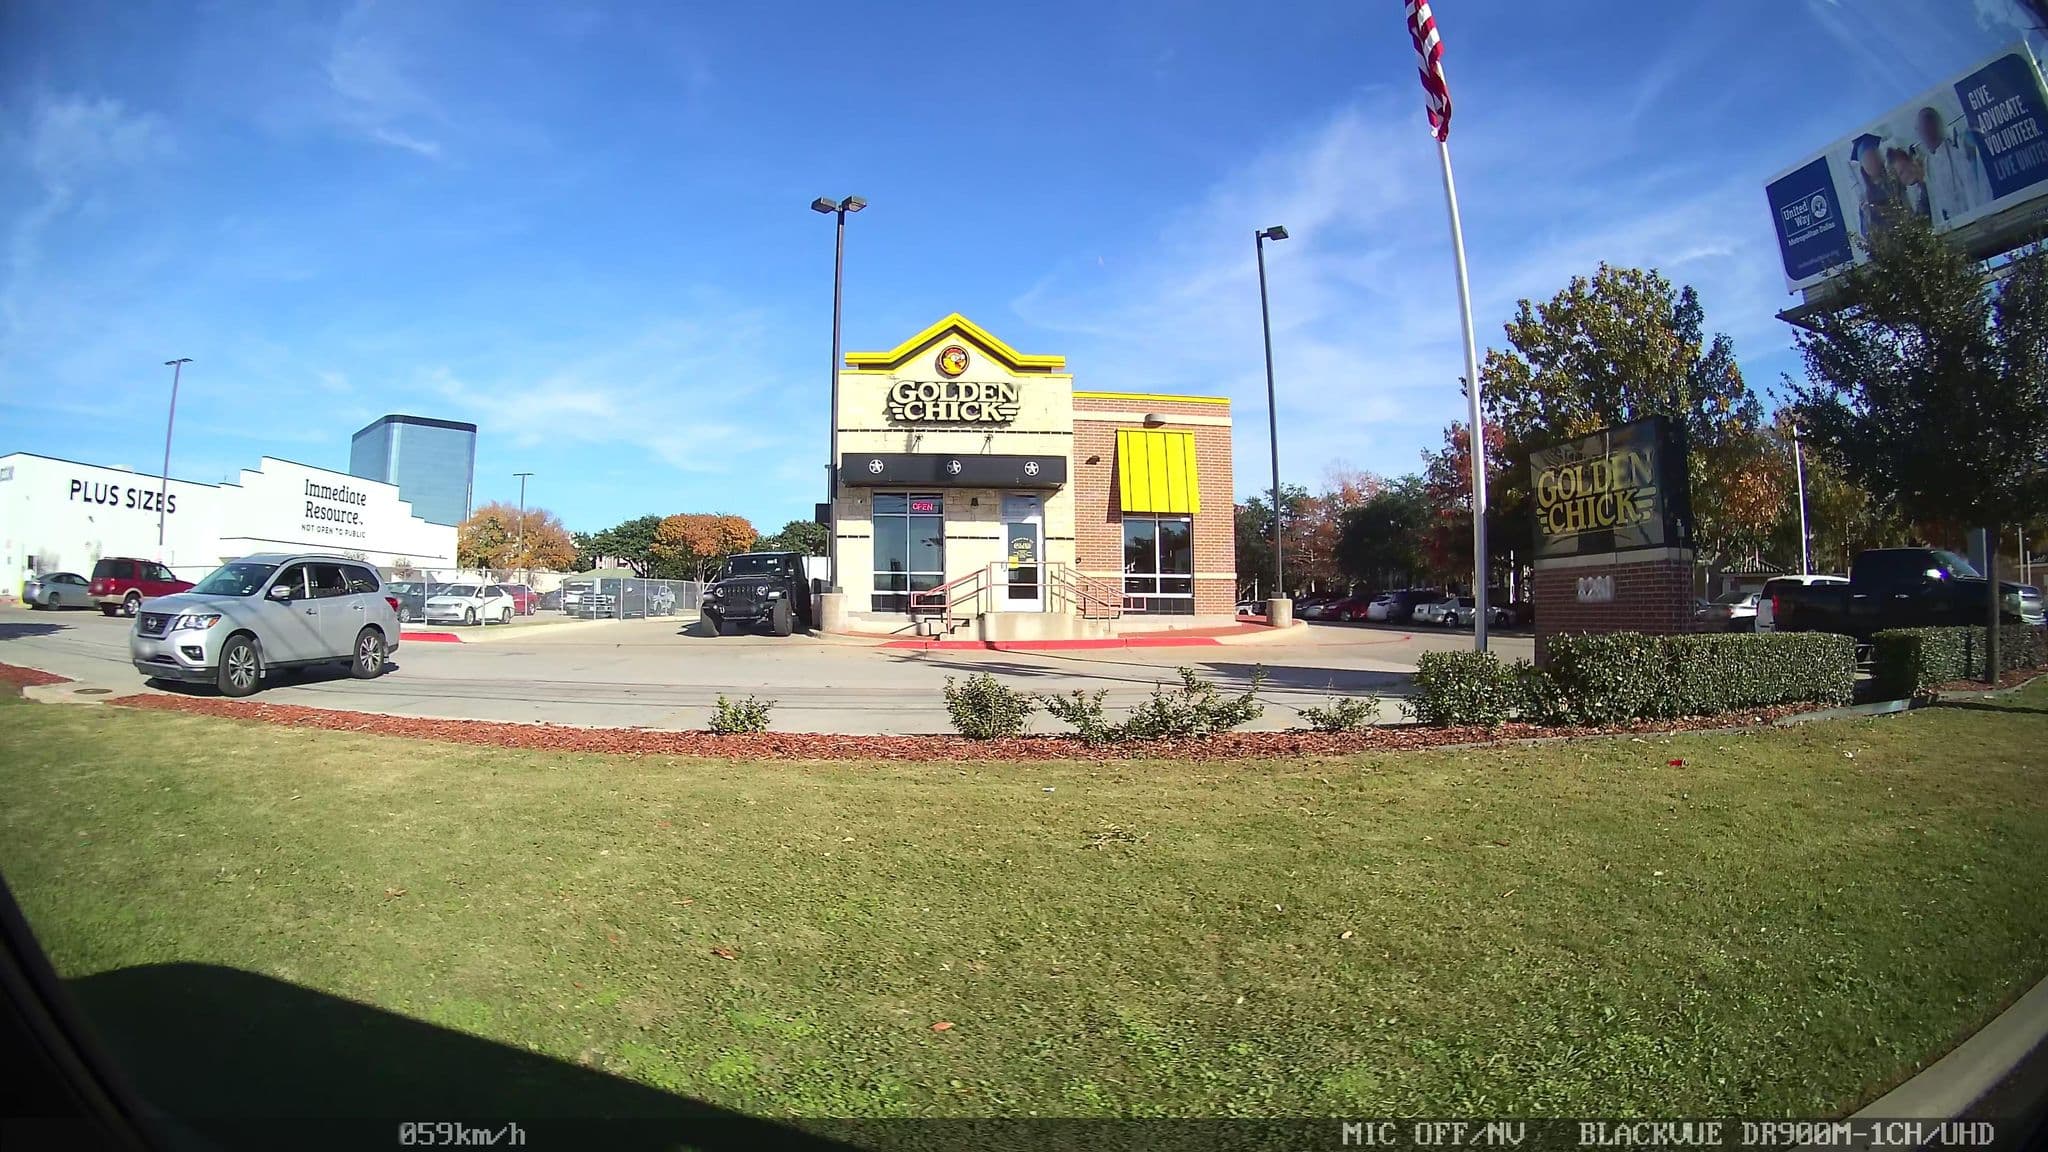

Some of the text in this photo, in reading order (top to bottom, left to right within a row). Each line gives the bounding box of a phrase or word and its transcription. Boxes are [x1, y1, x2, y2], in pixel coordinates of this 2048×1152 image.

[1967, 84, 1995, 110] GIVE.
[1977, 94, 2029, 134] ADVOCATE.
[1984, 117, 2044, 156] VOLUNTEER.
[1993, 154, 2018, 181] LIVE
[1783, 200, 1808, 220] United
[1794, 213, 1810, 228] Way
[890, 380, 1020, 404] GOLDEN
[903, 401, 1005, 422] CHICK
[304, 478, 367, 506] Immediate
[1537, 449, 1656, 509] GOLDEN
[69, 479, 177, 514] PLUS SIZES
[912, 502, 933, 511] OPEN
[1549, 487, 1644, 534] CHICK
[301, 524, 366, 539] NOT OPEN TO PUBLIC
